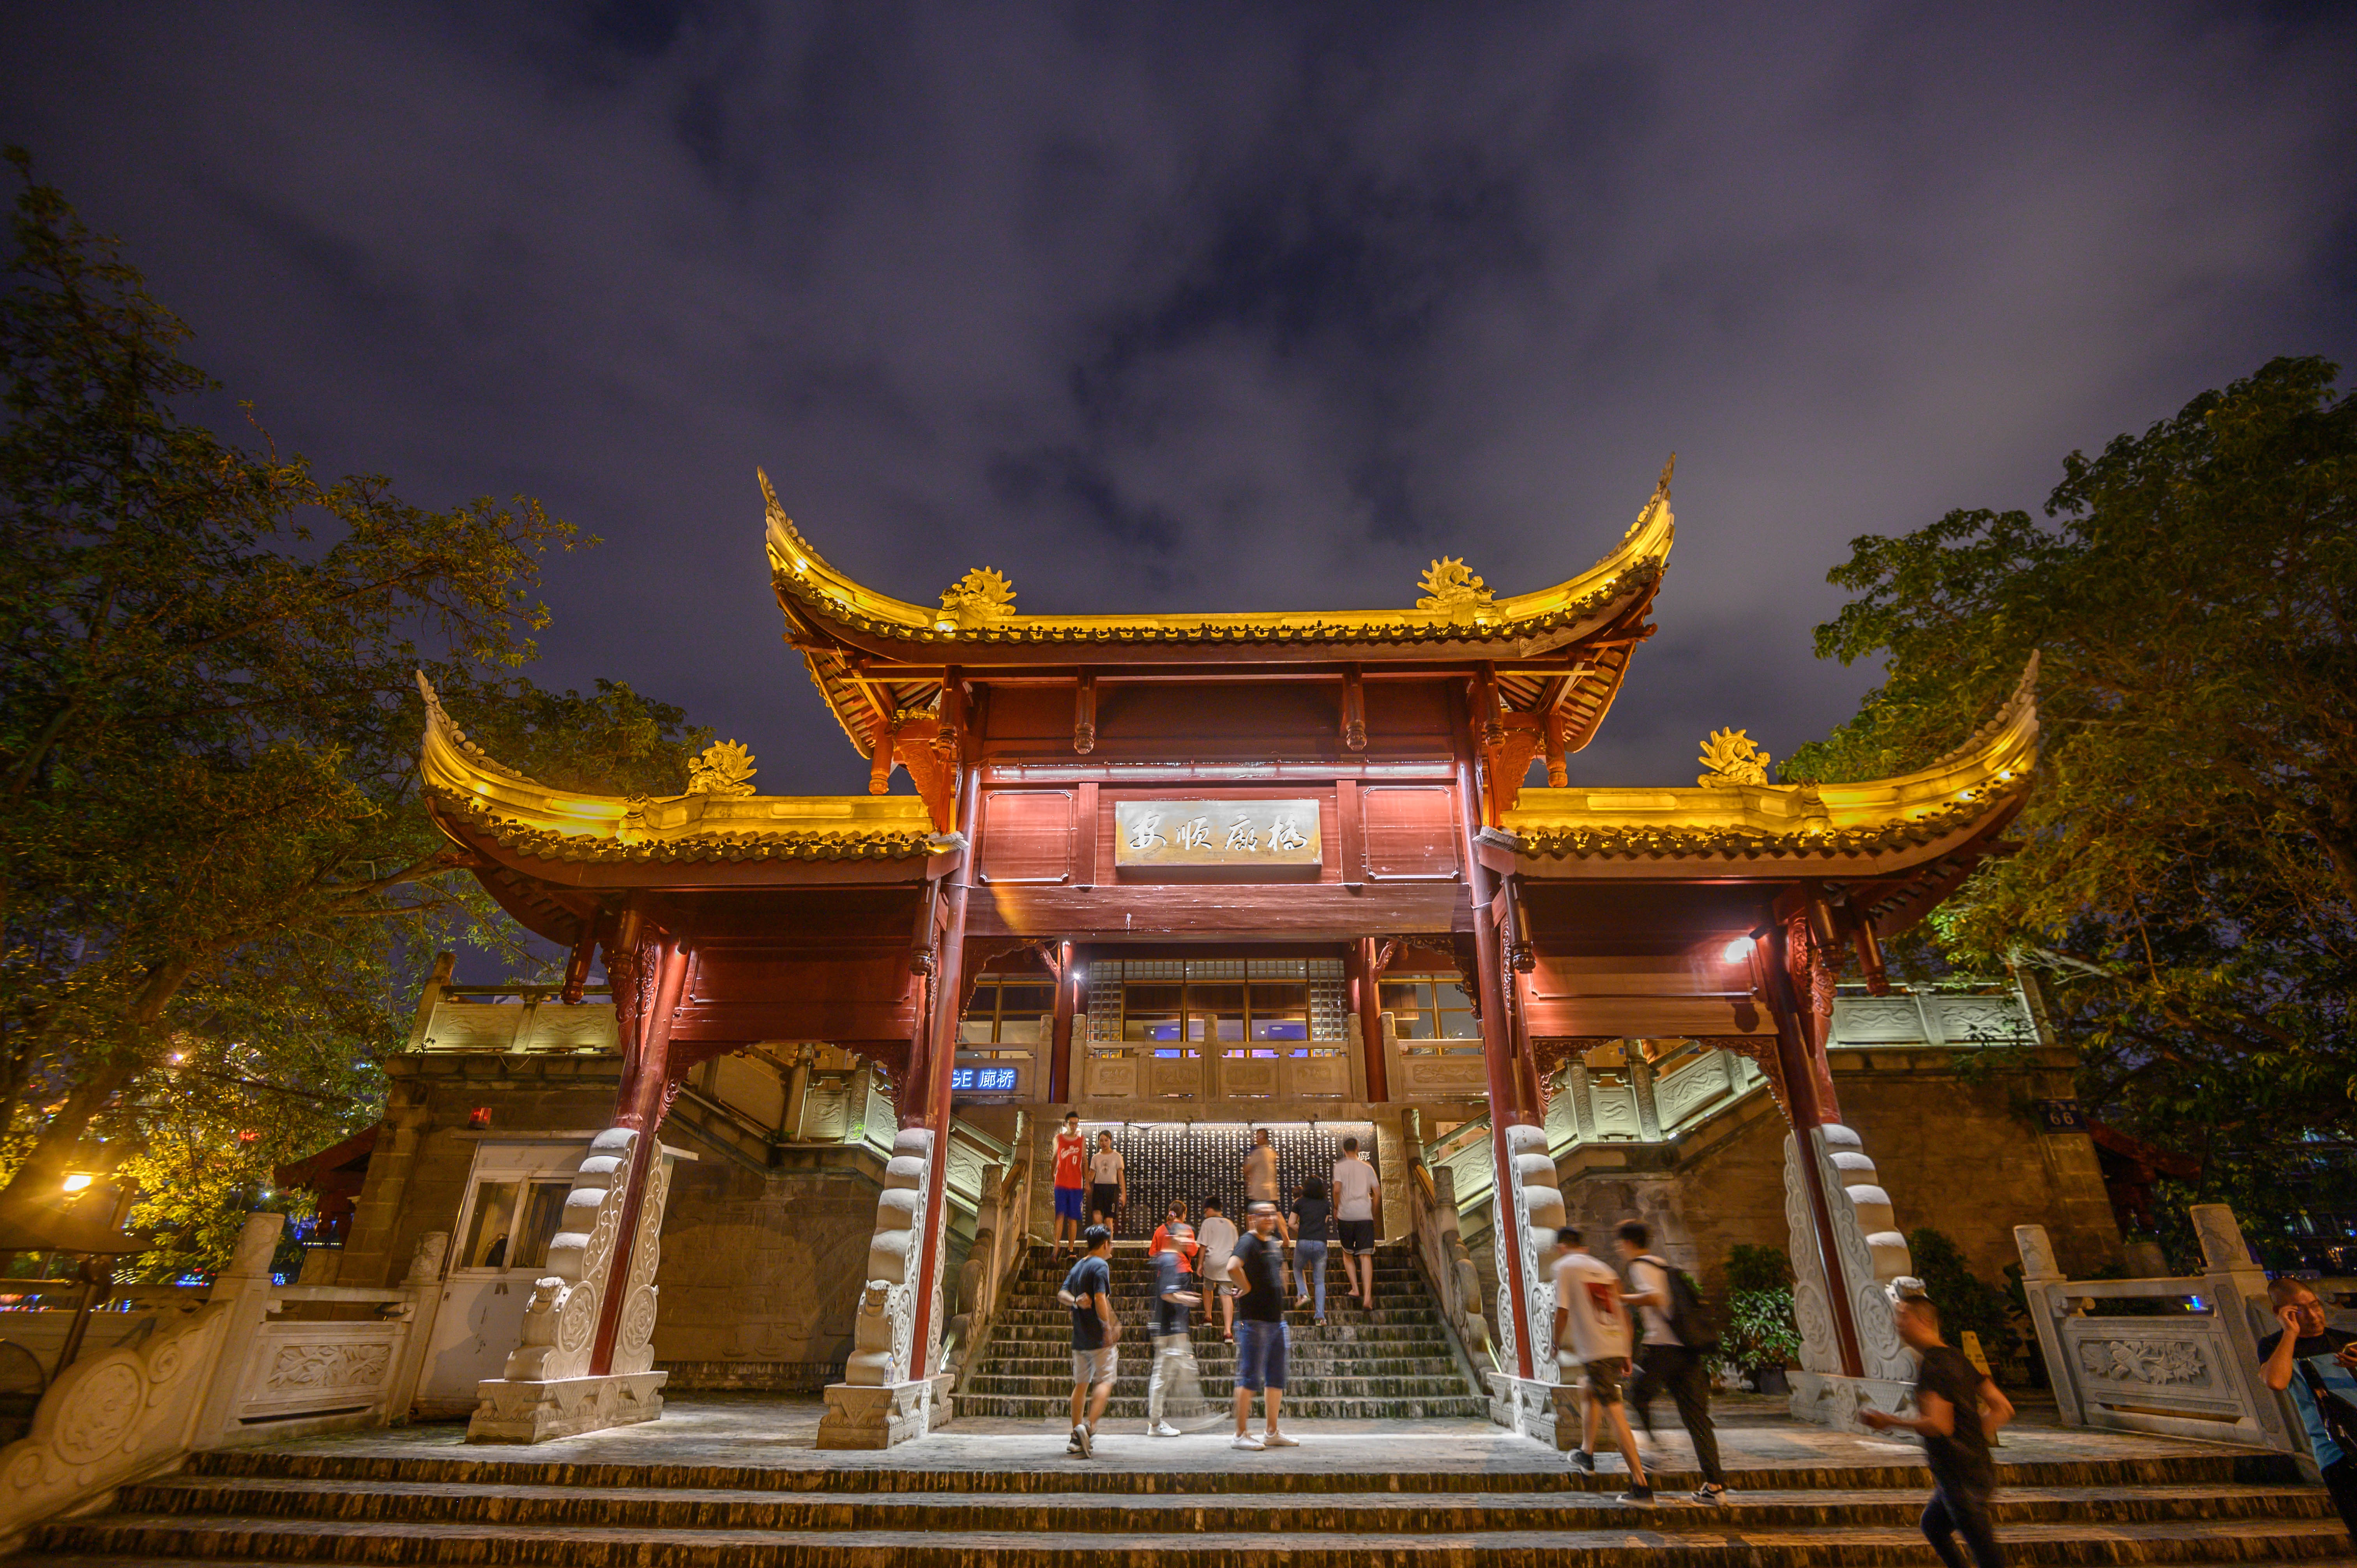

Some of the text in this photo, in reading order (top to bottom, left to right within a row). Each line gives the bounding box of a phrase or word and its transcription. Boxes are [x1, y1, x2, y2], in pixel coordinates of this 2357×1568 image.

[979, 1068, 1013, 1088] 廊桥
[2050, 1111, 2074, 1125] 66
[1072, 1155, 1077, 1165] 0
